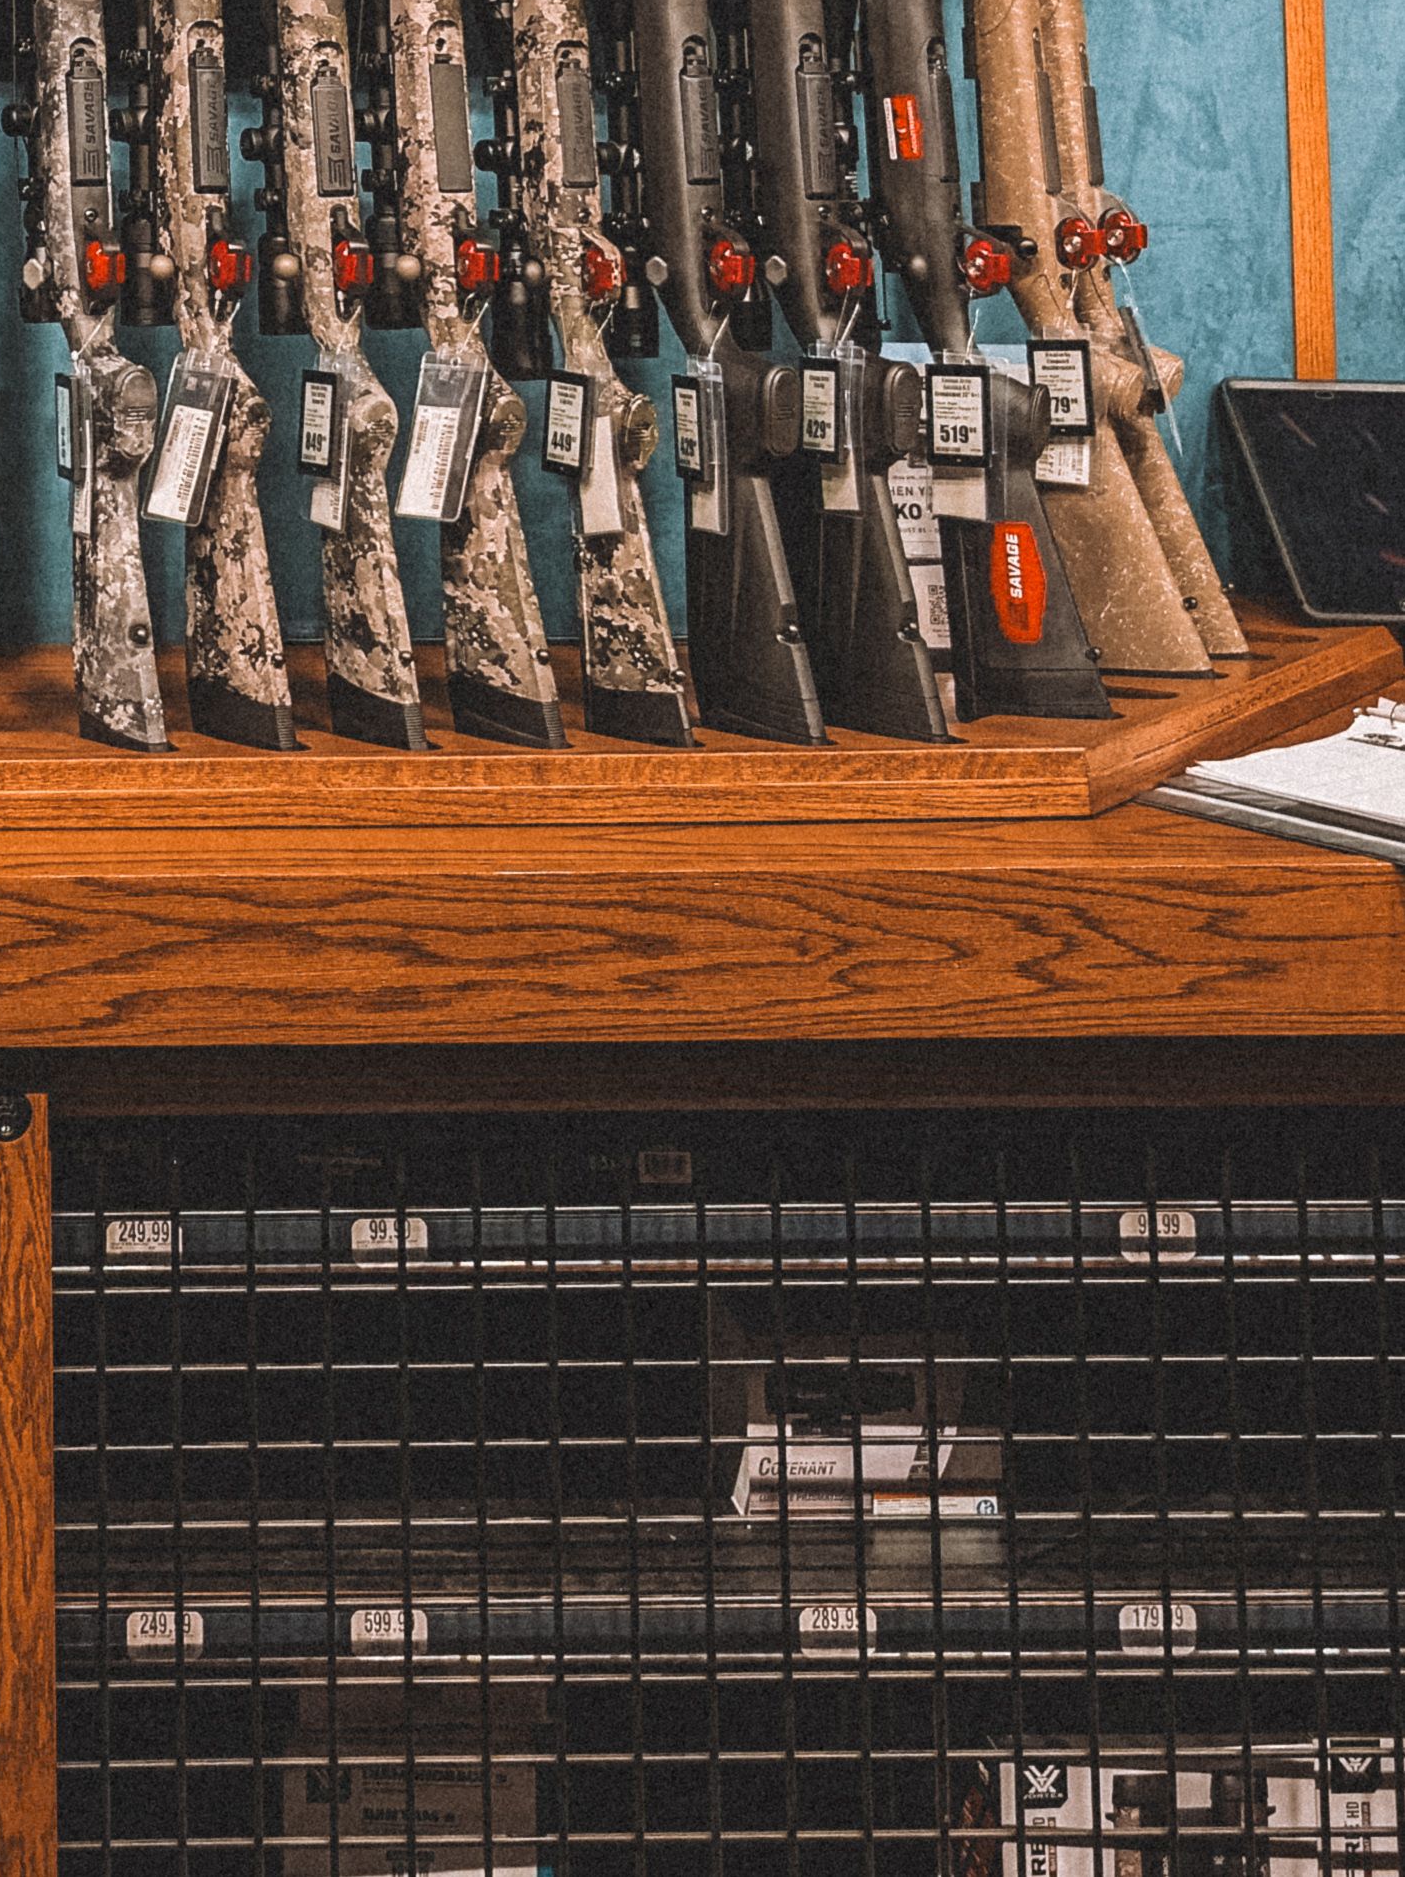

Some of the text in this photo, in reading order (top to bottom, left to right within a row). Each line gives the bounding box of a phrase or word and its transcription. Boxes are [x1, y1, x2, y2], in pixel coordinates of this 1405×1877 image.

[85, 80, 95, 145] SAVAGE
[1051, 396, 1071, 414] 79
[806, 419, 827, 440] 429
[940, 424, 970, 444] 519
[551, 430, 572, 452] 449
[1005, 533, 1023, 599] SAVAGE
[118, 1221, 170, 1242] 249.99
[1138, 1213, 1180, 1235] 9.99
[758, 1457, 838, 1476] COENANT
[140, 1612, 192, 1634] 249.9
[364, 1611, 415, 1634] 599.9
[811, 1607, 860, 1630] 289.9
[1132, 1606, 1184, 1628] 1799
